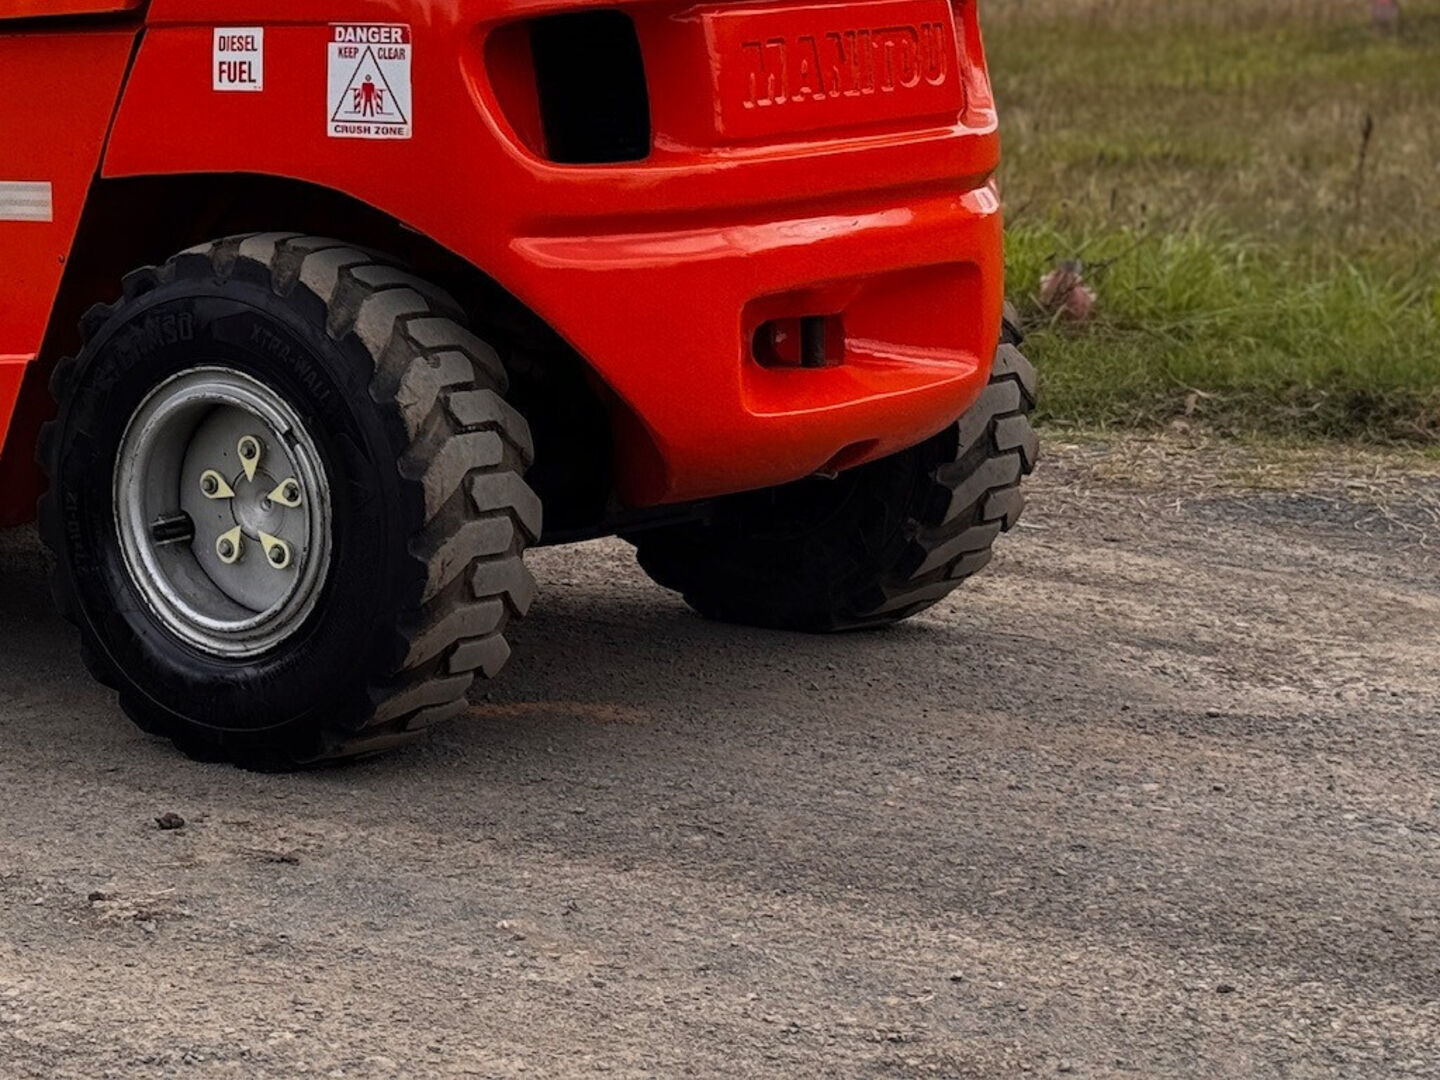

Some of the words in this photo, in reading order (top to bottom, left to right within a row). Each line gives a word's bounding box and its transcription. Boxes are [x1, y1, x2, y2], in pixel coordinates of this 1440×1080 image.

[218, 34, 258, 52] DIESEL
[334, 26, 403, 43] DANGER
[337, 45, 360, 59] KEEP
[377, 46, 406, 61] CLEAR
[218, 60, 257, 84] FUEL
[741, 21, 947, 110] MANITOU
[333, 124, 371, 135] CRUSH
[373, 125, 405, 136] ZONE
